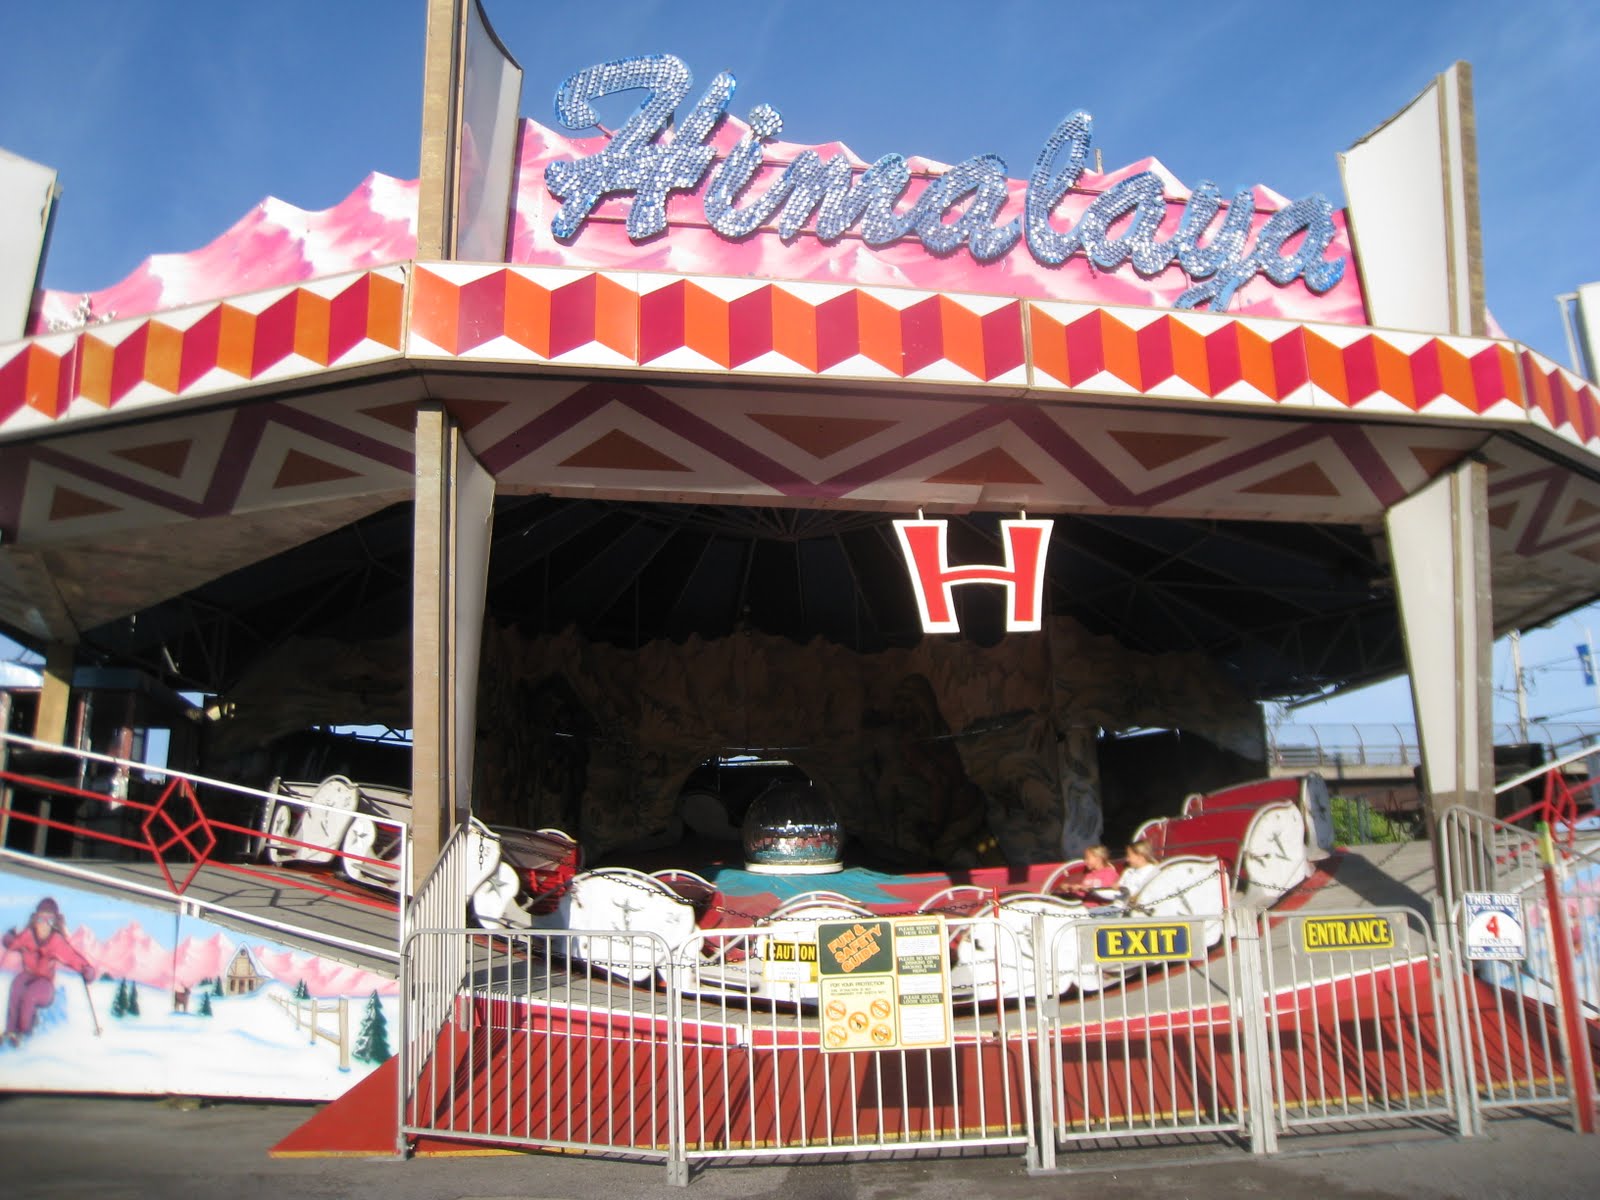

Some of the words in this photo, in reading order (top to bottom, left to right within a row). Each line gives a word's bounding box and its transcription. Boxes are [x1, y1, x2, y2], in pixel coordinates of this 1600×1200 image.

[544, 54, 1346, 312] Himalaya
[892, 519, 1054, 634] H
[1467, 895, 1491, 905] THIS
[1494, 895, 1519, 905] RIDE
[827, 929, 856, 954] FUN
[853, 923, 867, 936] &
[1308, 920, 1389, 946] ENTRANCE
[1486, 916, 1499, 938] 4
[769, 945, 815, 960] AUTON
[834, 923, 882, 963] SAFETY
[841, 941, 881, 973] GUIDE
[1107, 929, 1178, 956] EXIT
